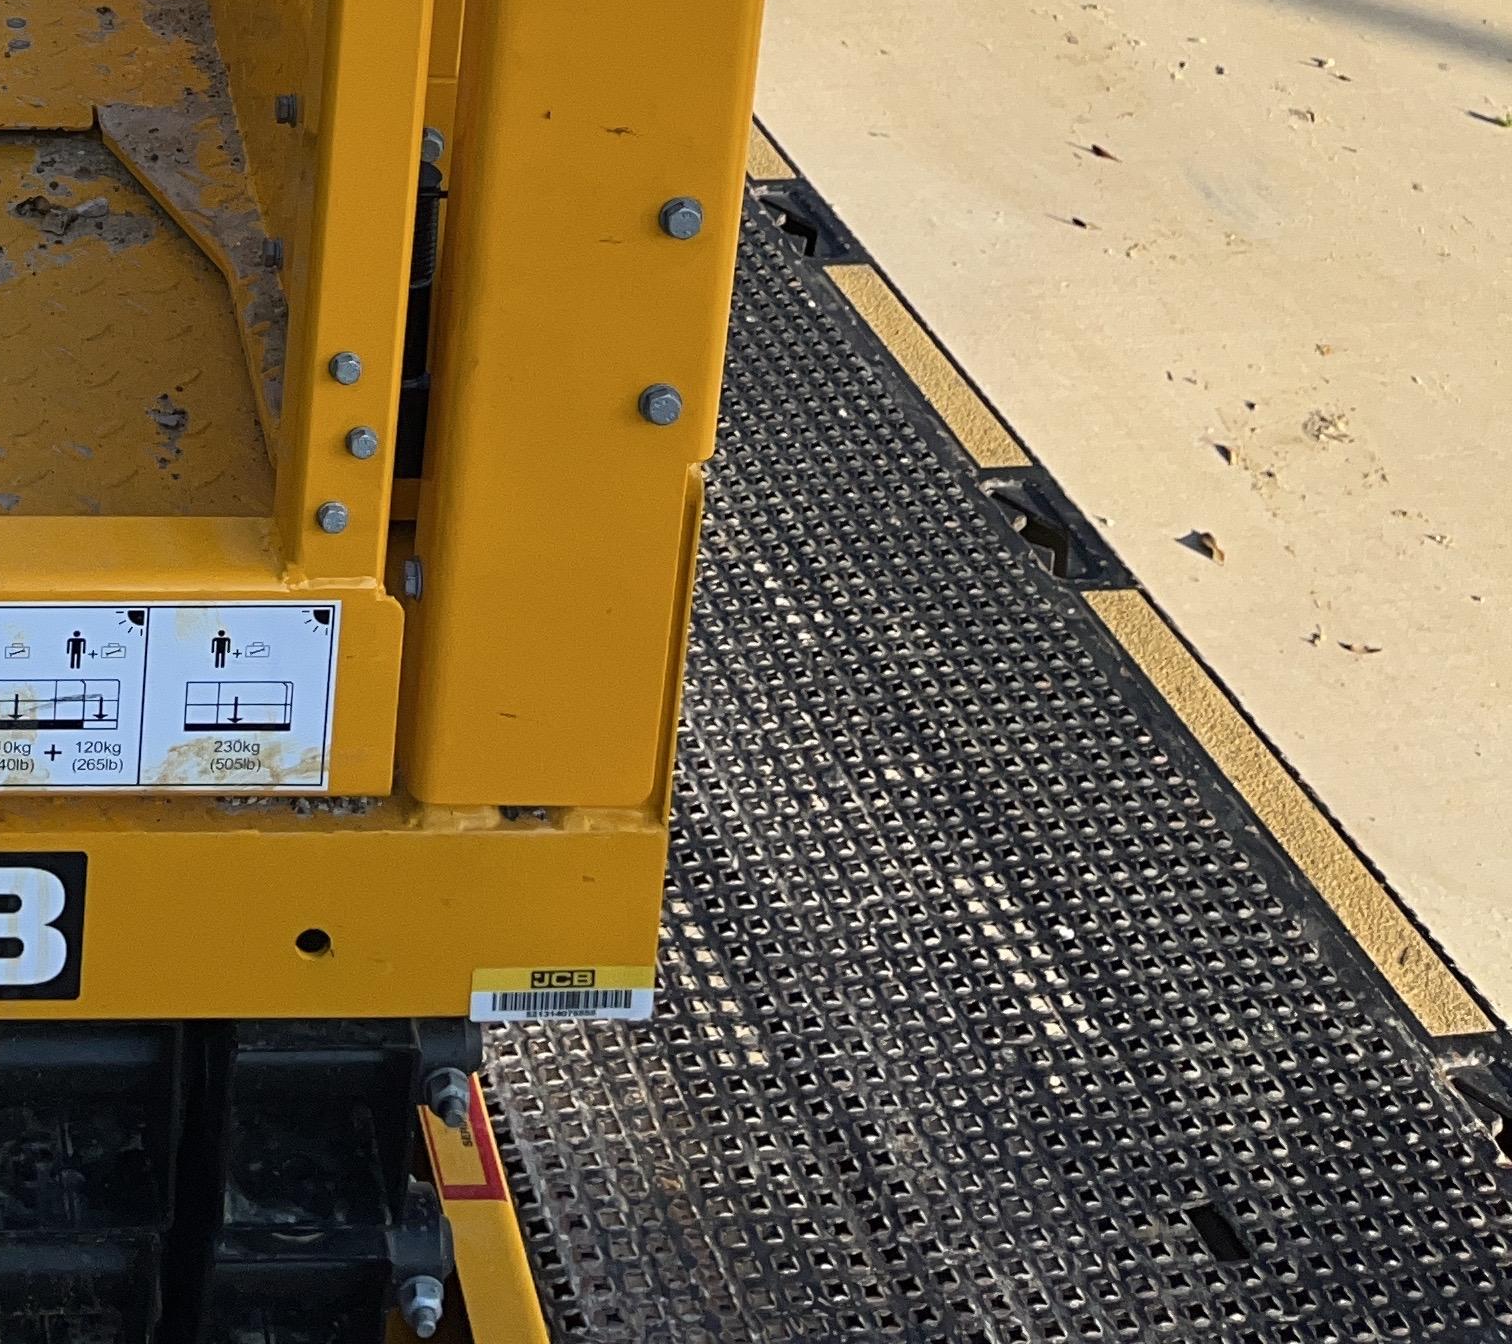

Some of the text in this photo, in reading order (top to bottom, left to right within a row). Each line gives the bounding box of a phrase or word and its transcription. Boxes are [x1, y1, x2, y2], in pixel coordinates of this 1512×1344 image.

[75, 740, 122, 757] 120kg
[213, 739, 261, 756] 230kg
[71, 757, 124, 774] (265lb)
[209, 756, 262, 774] (505lb)
[532, 970, 594, 988] JCB
